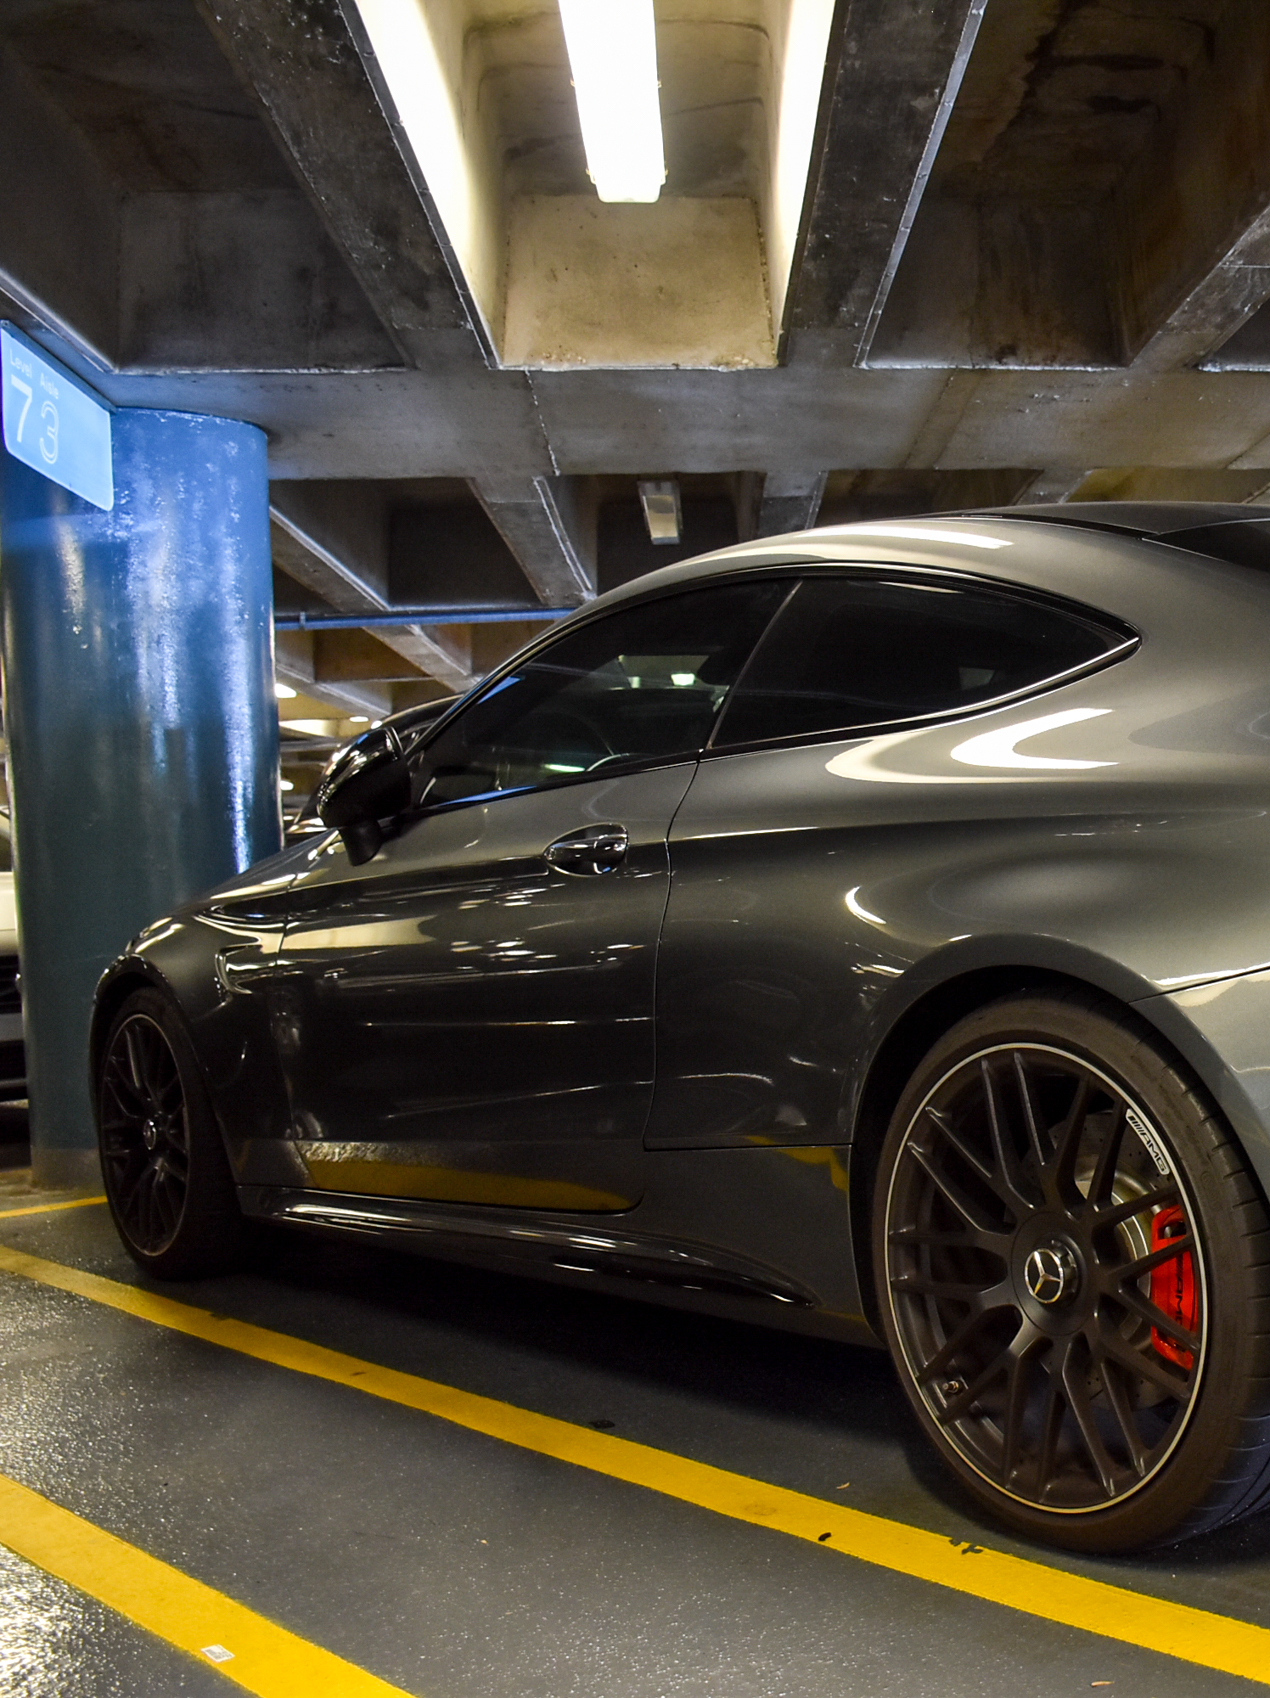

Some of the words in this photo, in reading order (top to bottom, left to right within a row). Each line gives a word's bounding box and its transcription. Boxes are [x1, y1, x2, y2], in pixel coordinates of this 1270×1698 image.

[9, 349, 32, 379] Level
[39, 372, 59, 400] Aisle
[10, 374, 33, 443] 7
[39, 400, 59, 464] 3
